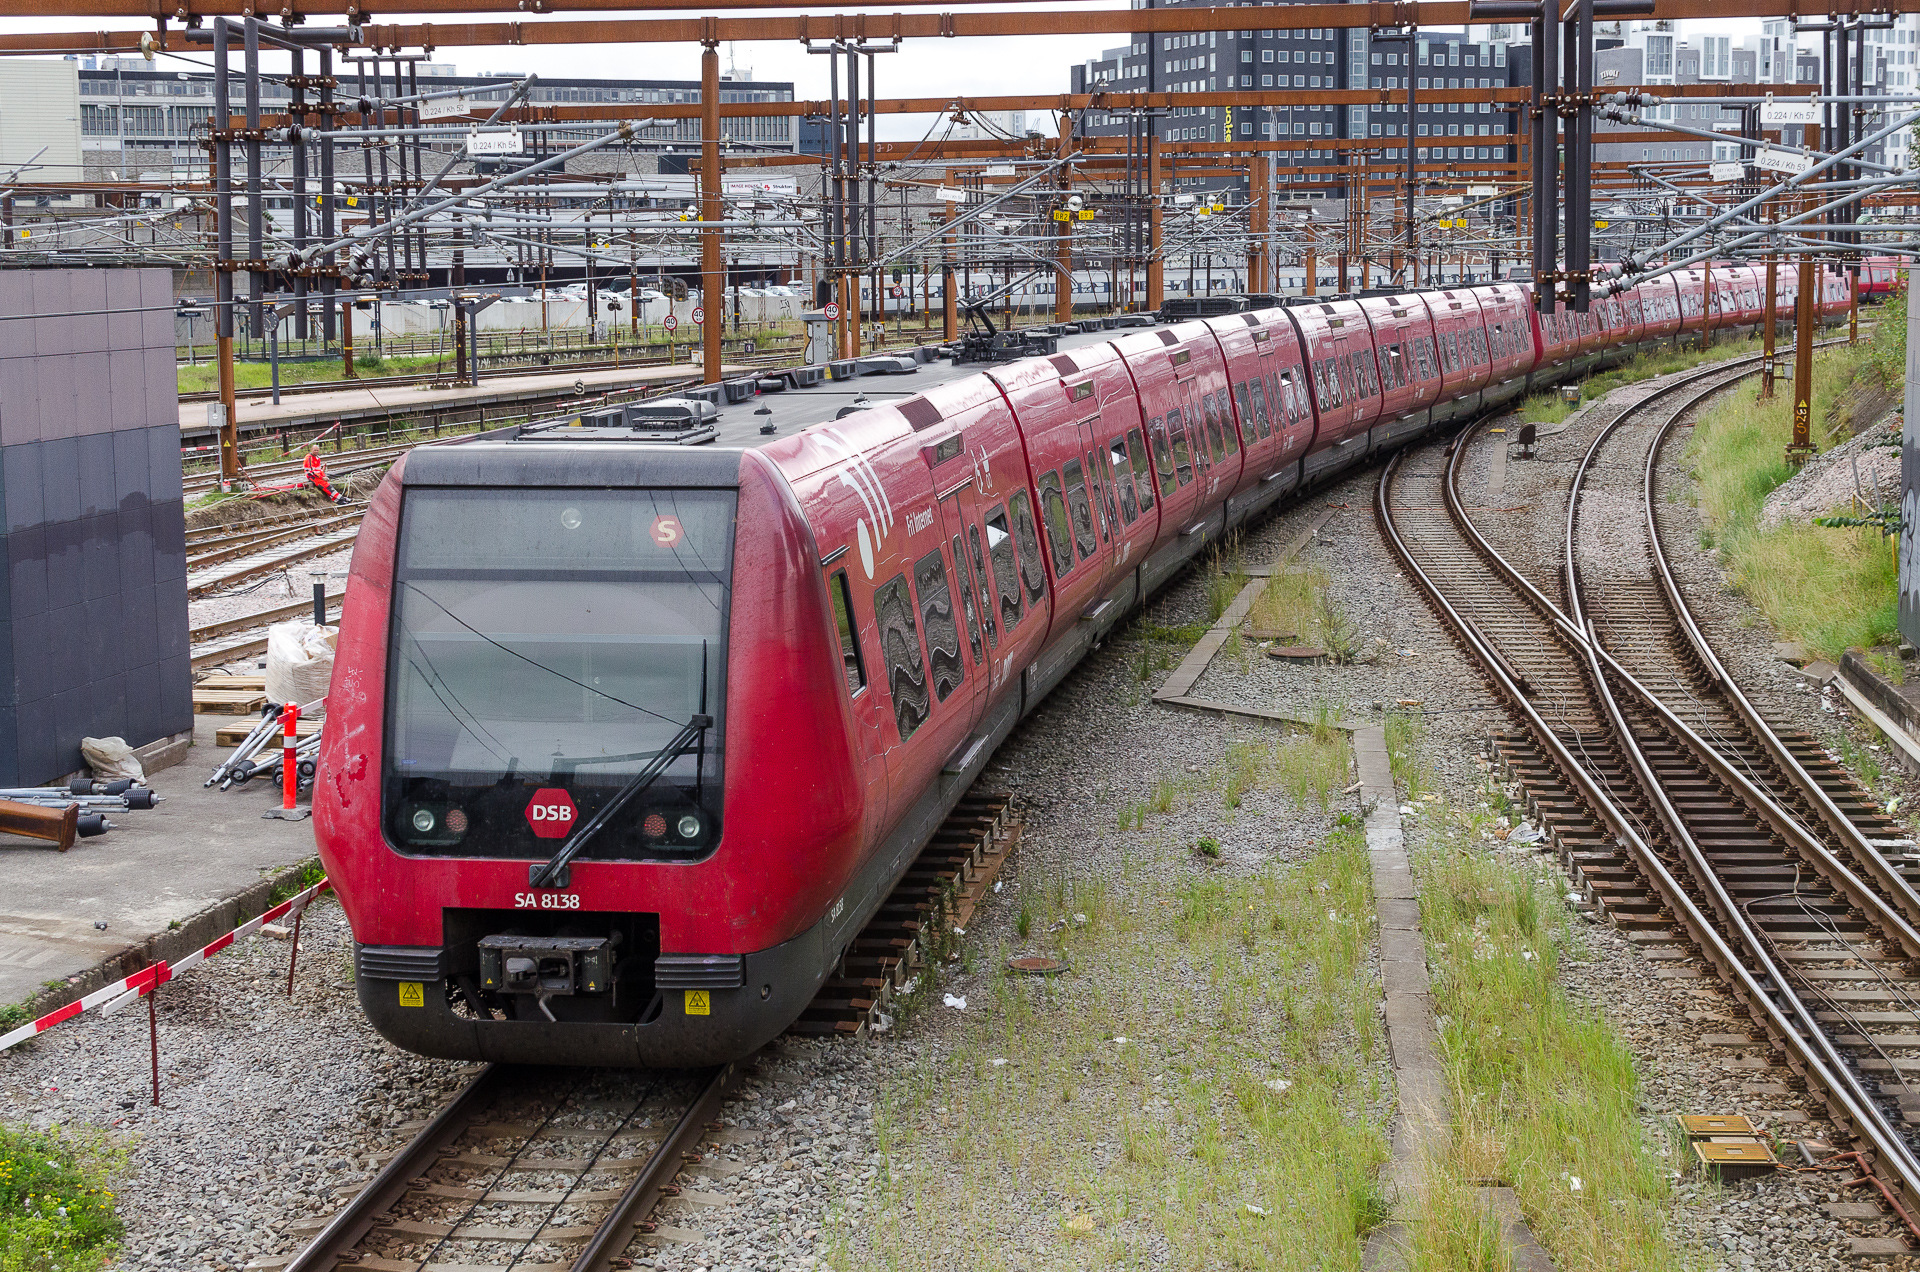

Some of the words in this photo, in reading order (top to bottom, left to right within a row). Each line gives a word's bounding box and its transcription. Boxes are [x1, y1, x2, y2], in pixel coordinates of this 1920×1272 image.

[1600, 70, 1620, 79] TIVOLI
[424, 108, 442, 116] 0.224
[1760, 157, 1780, 166] 0.224
[1786, 162, 1796, 170] Kh
[694, 310, 703, 318] 40
[827, 305, 838, 313] 40
[575, 382, 584, 393] S
[912, 505, 934, 533] Internet
[658, 520, 676, 542] S
[532, 805, 572, 821] DSB
[514, 893, 537, 908] SA
[541, 894, 580, 909] 8138
